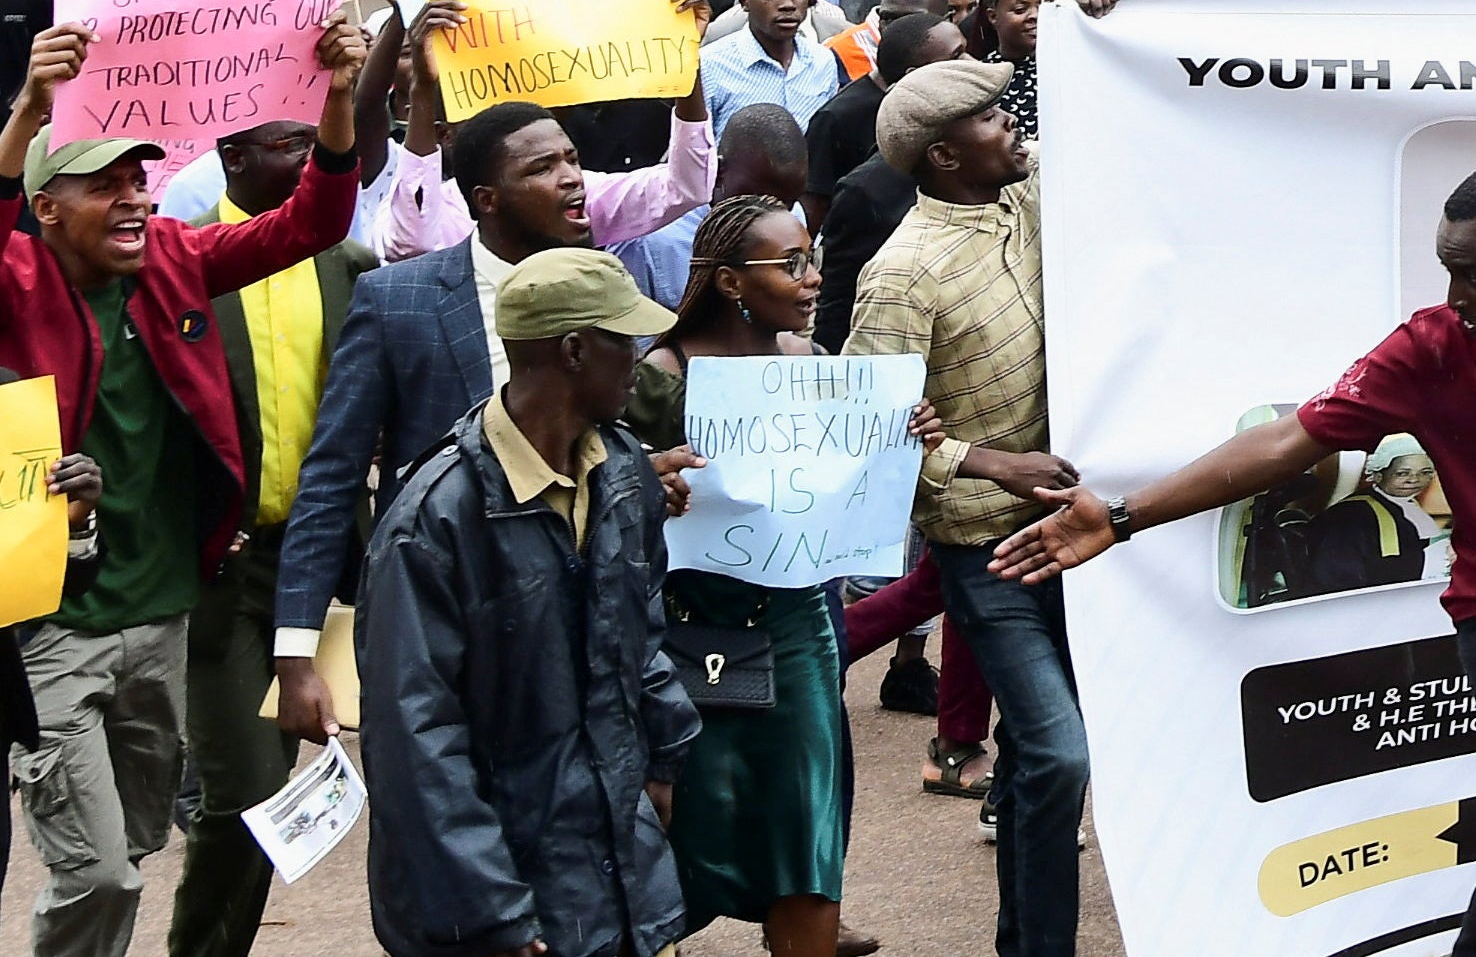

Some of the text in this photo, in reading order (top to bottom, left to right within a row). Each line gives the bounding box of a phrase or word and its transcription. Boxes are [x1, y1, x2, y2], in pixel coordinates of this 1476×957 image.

[87, 43, 298, 91] TRADITIONAL
[447, 35, 687, 110] HOMOSEXUALITY
[1178, 58, 1391, 89] YOUTH
[84, 83, 264, 134] VALUES
[768, 467, 869, 514] IS A
[1278, 691, 1376, 725] YOUTH
[1384, 687, 1402, 705] &
[1352, 714, 1372, 732] &
[1379, 704, 1425, 728] H.E
[1375, 724, 1441, 750] ANTI
[1297, 842, 1389, 888] DATE:
